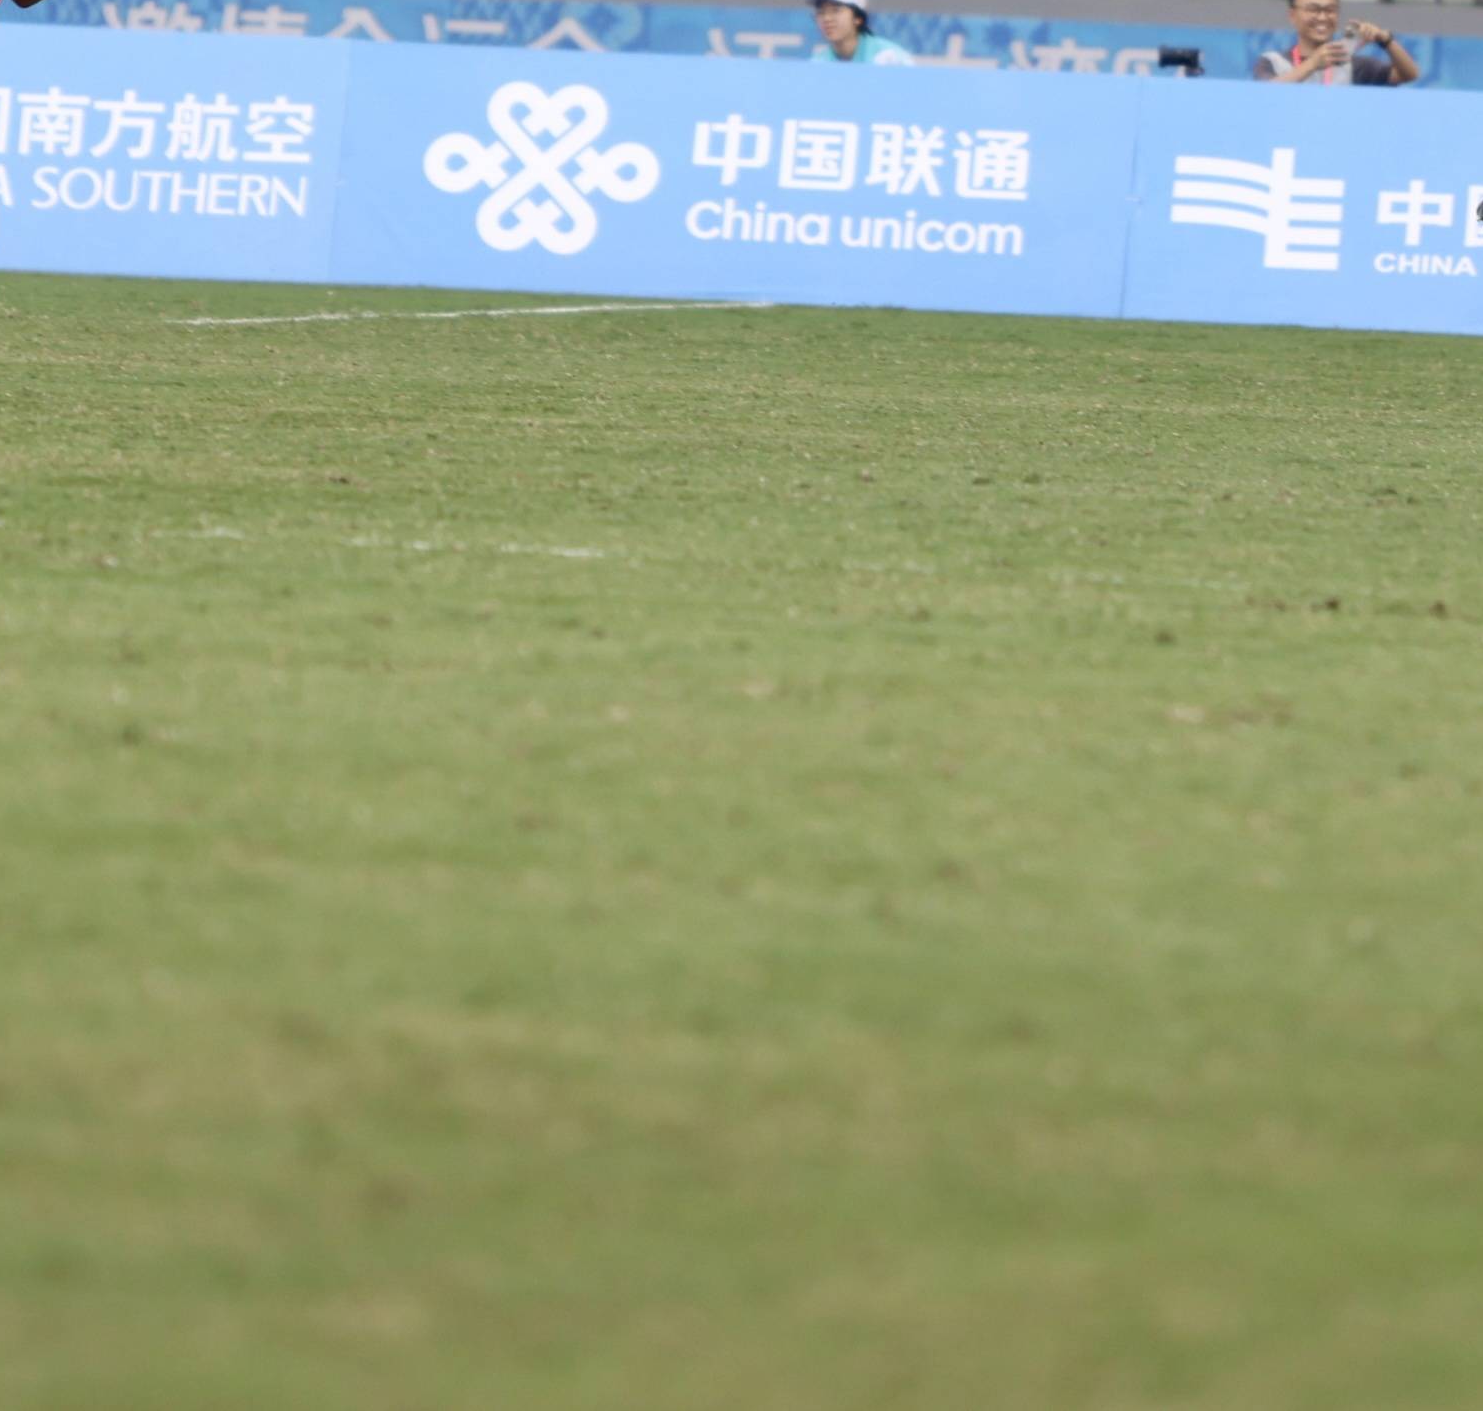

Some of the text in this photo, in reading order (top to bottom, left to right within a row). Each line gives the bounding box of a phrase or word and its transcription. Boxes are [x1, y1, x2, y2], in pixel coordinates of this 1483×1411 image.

[692, 114, 1030, 201] 中国联通
[31, 166, 307, 216] SOUTHERN
[685, 197, 1024, 256] China unicom
[1373, 253, 1476, 276] CHINA
